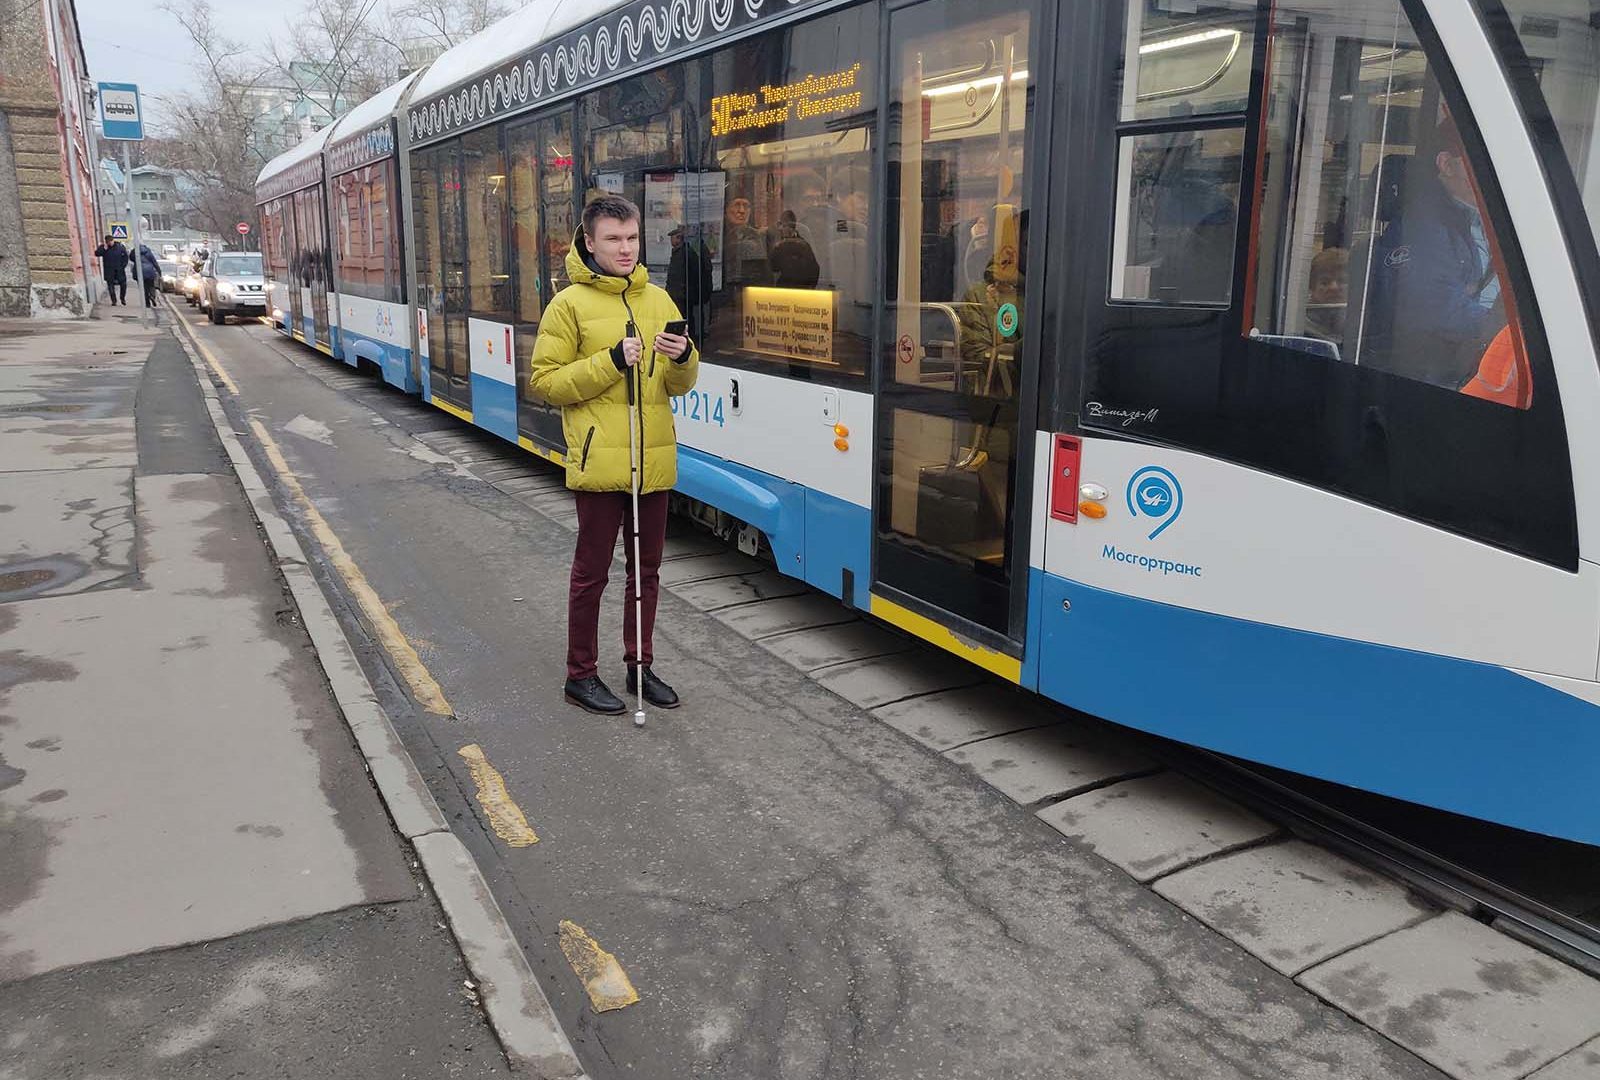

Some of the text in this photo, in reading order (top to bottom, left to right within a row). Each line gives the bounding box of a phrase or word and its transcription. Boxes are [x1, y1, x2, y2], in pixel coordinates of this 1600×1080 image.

[711, 96, 729, 136] 50
[730, 93, 757, 112] Метро
[745, 315, 756, 338] 50
[1102, 544, 1202, 577] Мосгортранс
